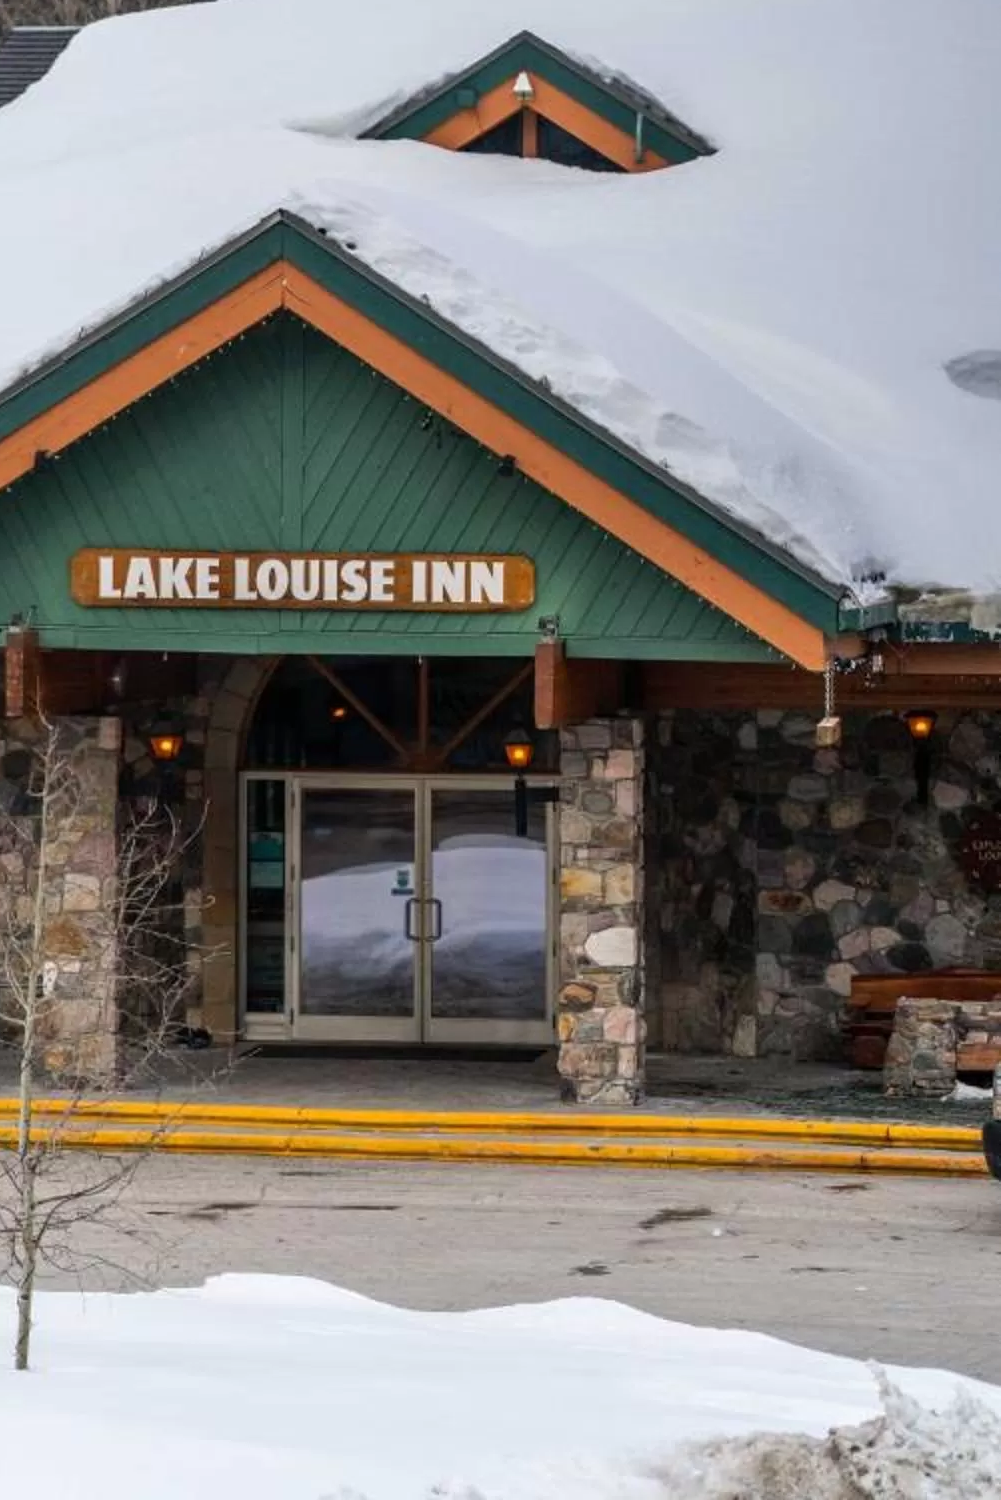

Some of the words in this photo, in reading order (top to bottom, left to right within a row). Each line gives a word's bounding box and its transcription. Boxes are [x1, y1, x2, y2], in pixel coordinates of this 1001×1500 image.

[98, 556, 220, 599] LAKE
[234, 558, 395, 602] LOUISE
[412, 561, 504, 604] INN
